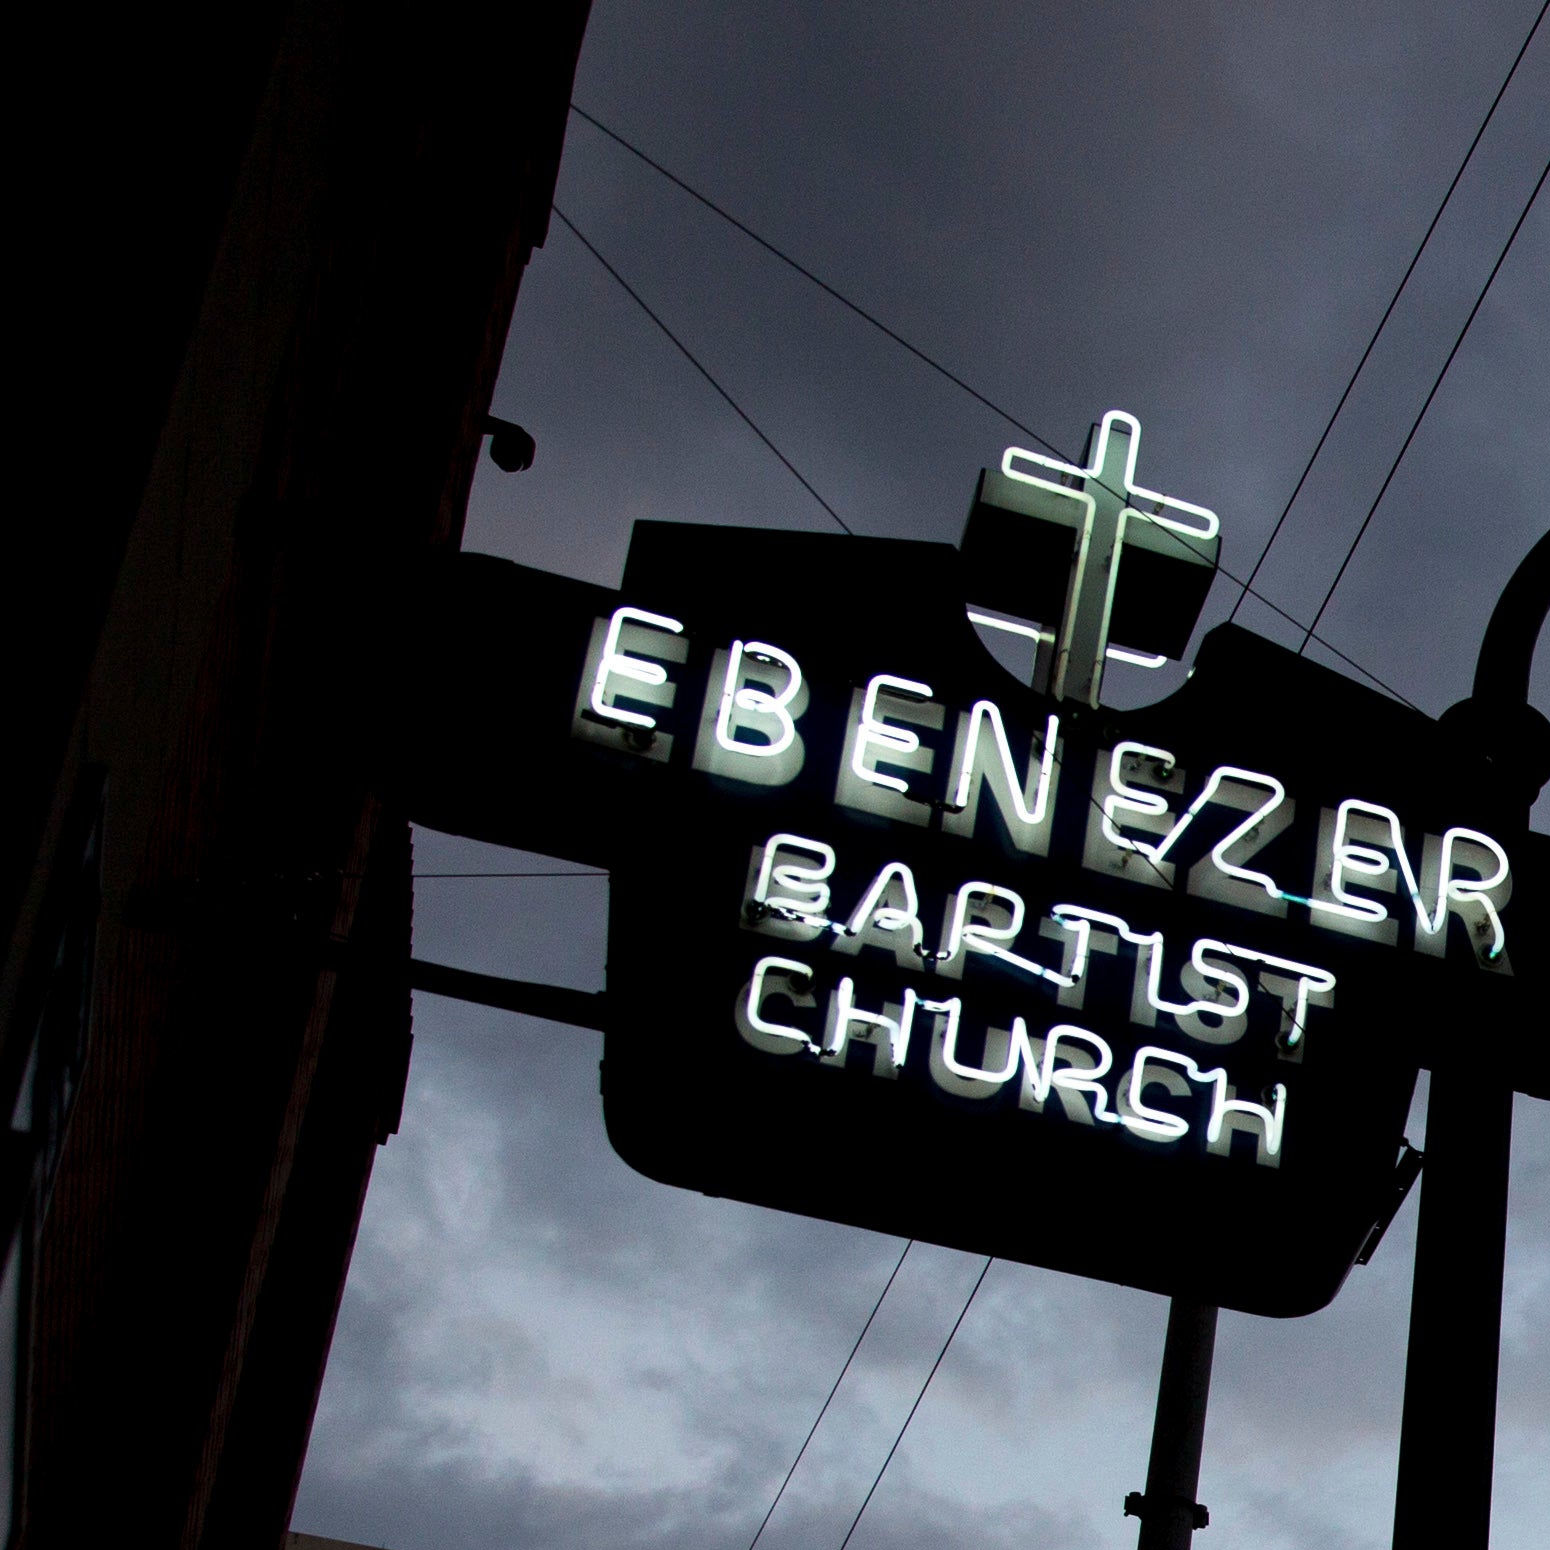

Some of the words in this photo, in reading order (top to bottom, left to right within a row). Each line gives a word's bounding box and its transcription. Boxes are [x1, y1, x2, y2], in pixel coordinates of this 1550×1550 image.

[570, 605, 1515, 977] EBENEZER
[734, 956, 1288, 1169] CHURCH
[738, 832, 1336, 1063] BAPTIST
